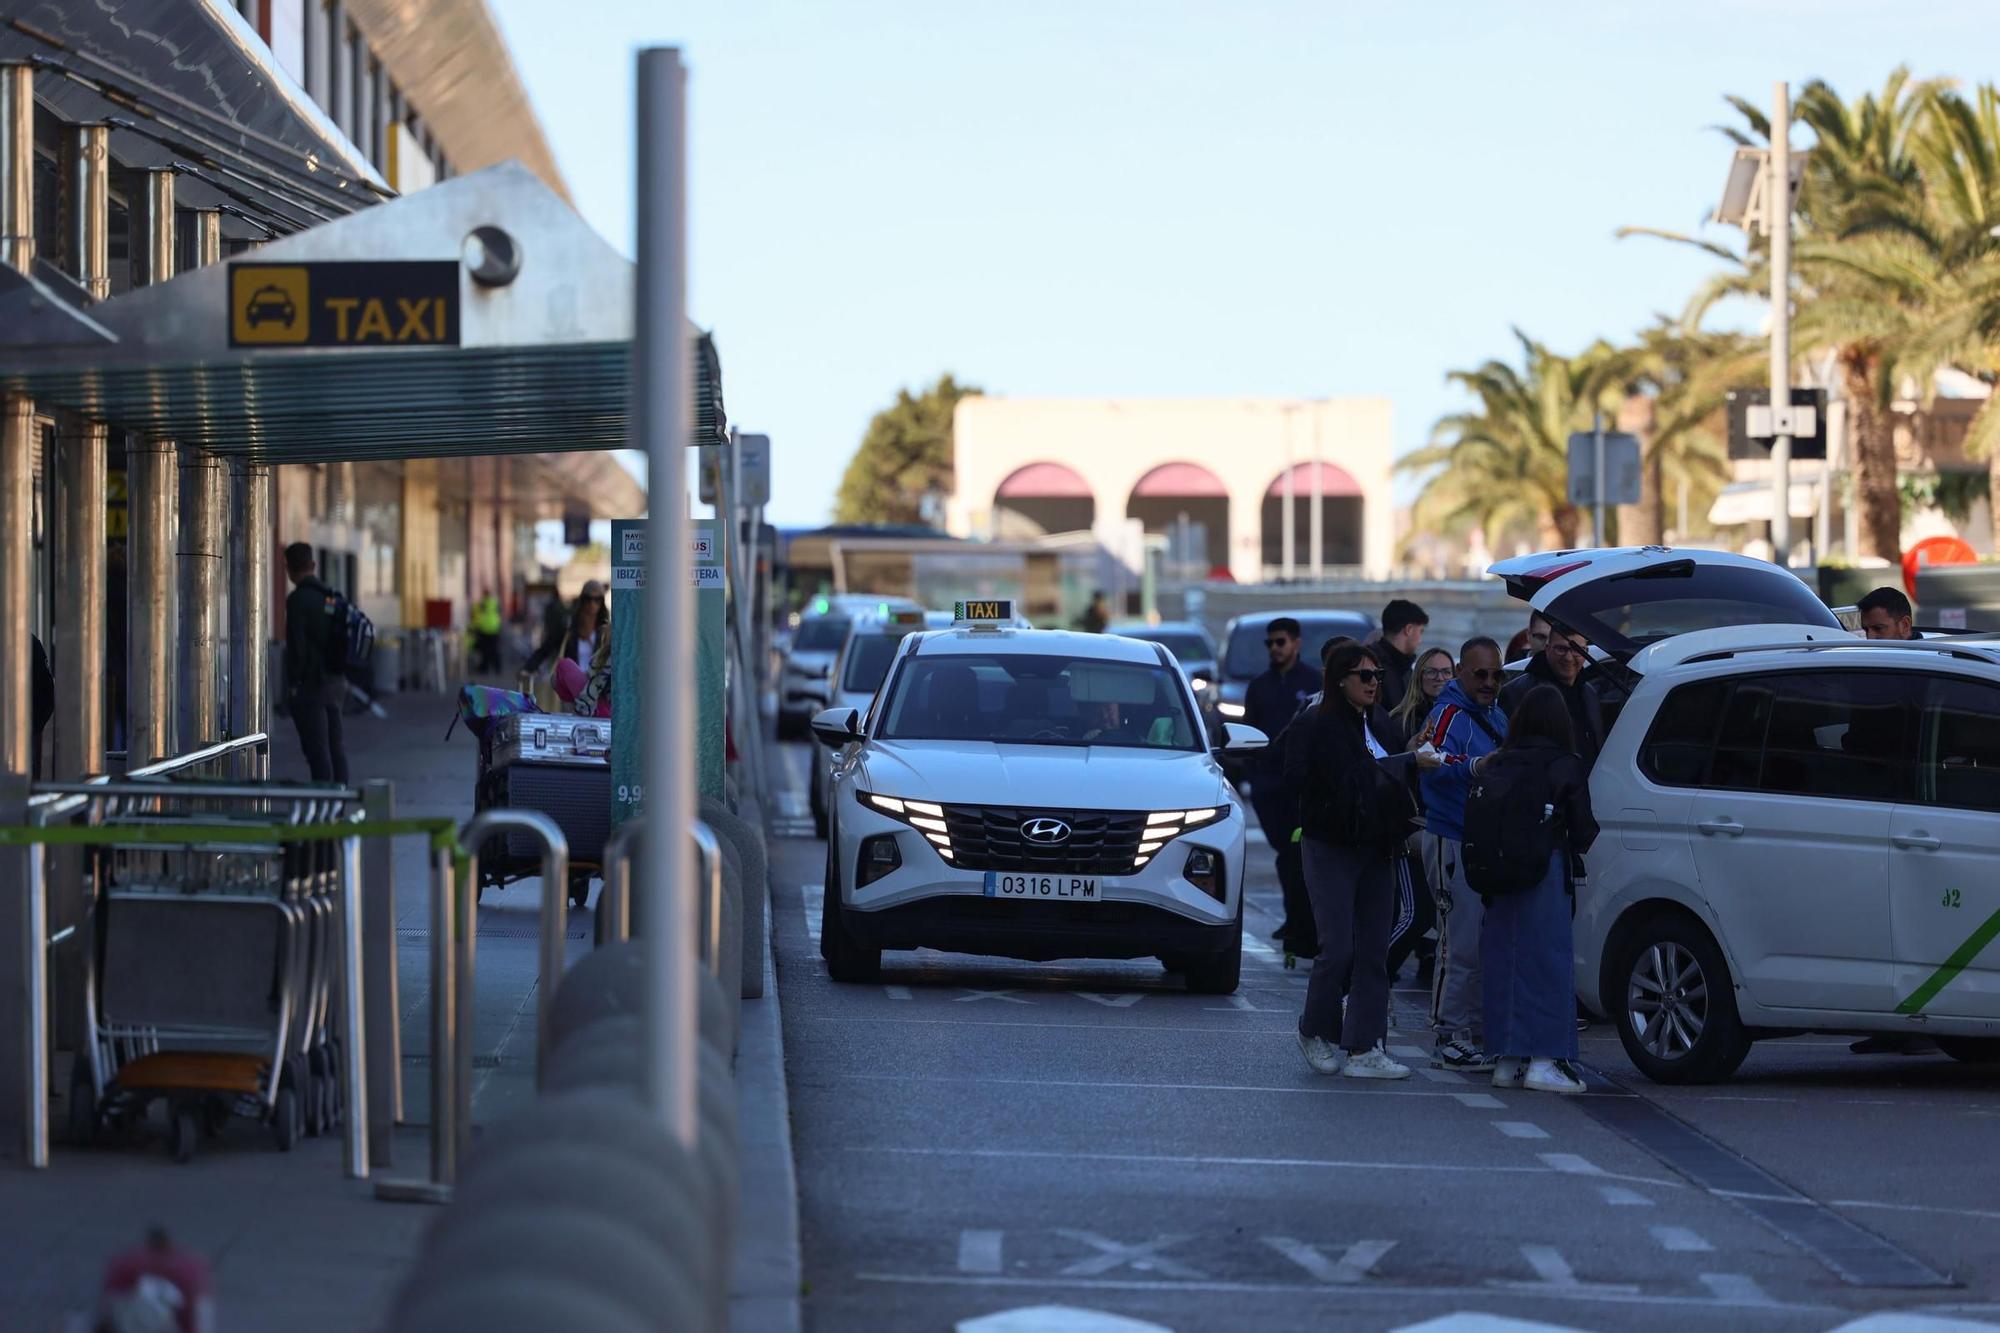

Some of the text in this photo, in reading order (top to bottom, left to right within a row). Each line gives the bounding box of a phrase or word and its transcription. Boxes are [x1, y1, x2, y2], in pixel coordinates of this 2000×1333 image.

[325, 298, 446, 341] TAXI
[617, 568, 642, 579] IBIZA
[967, 602, 999, 618] TAXI
[1002, 876, 1095, 897] 0316 LPM
